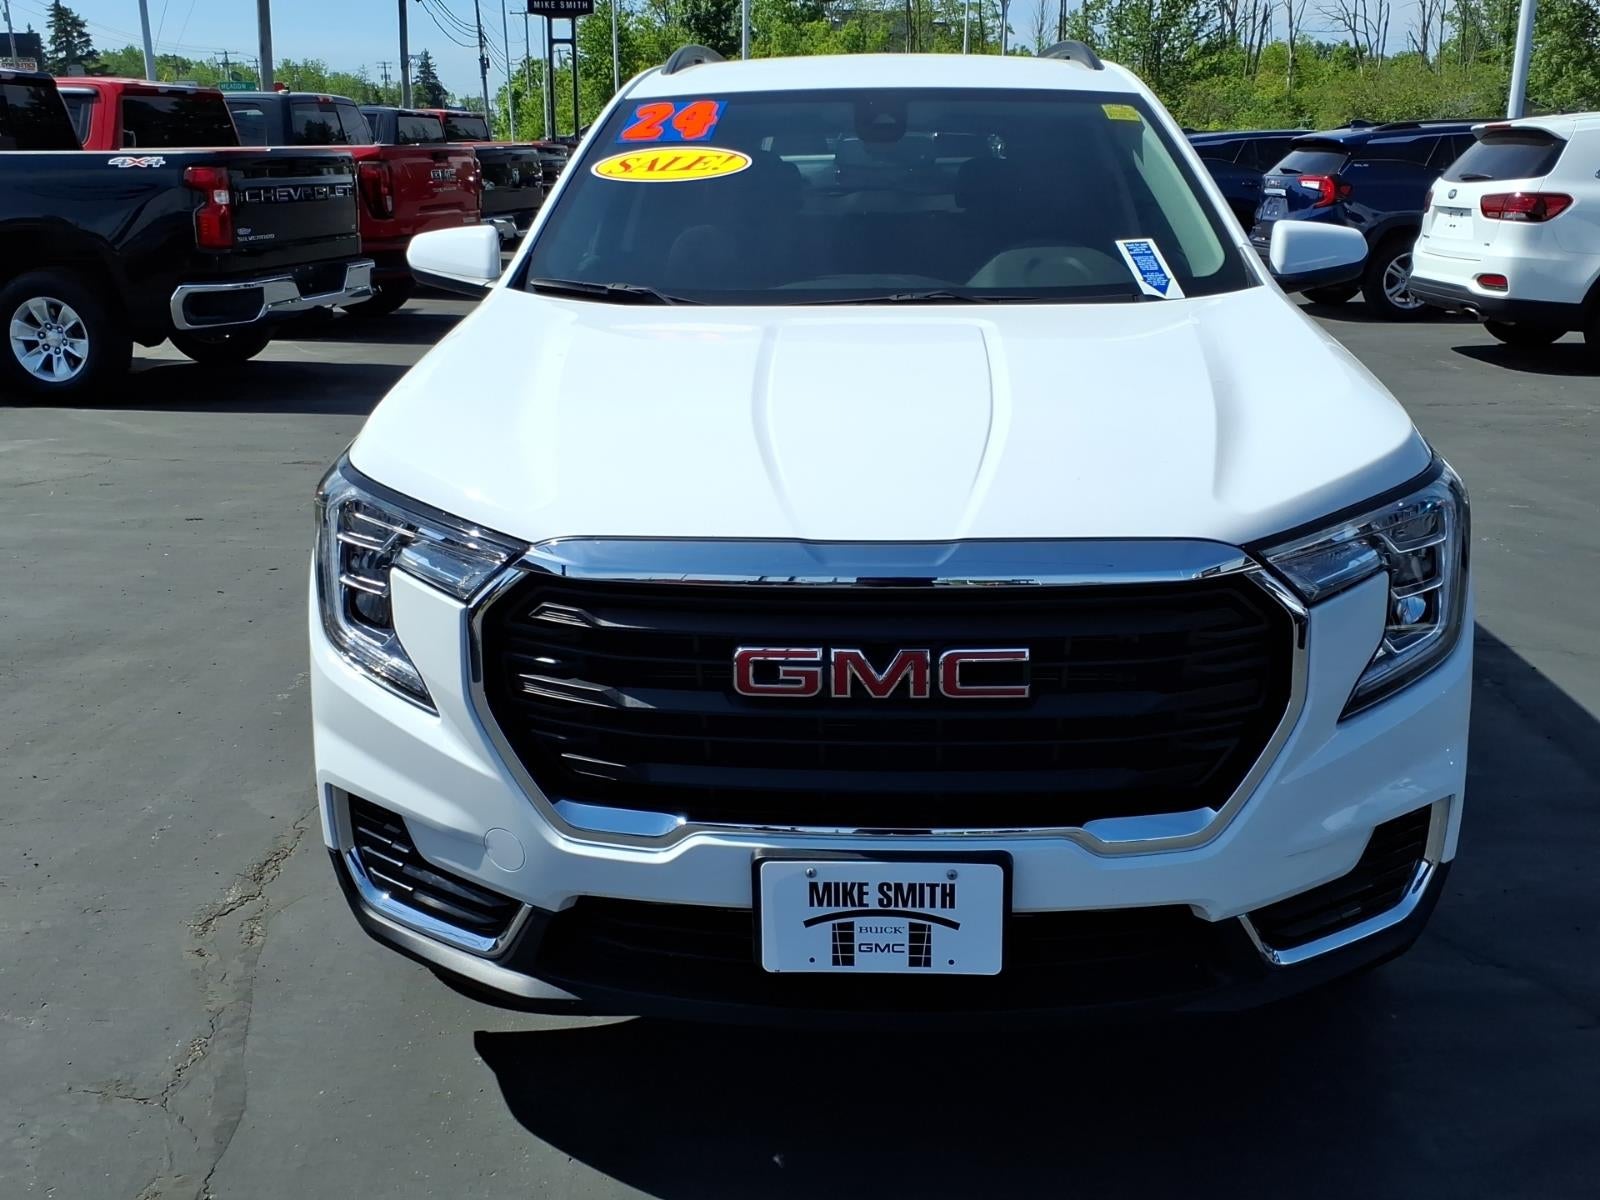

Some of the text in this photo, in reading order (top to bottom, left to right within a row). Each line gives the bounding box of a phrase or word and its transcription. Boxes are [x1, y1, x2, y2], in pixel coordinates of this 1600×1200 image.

[533, 1, 588, 9] MIKE SMITH
[620, 100, 719, 141] 24
[607, 154, 737, 174] SALE!
[245, 184, 353, 202] CHEVROLET
[733, 647, 1029, 699] GMC
[808, 881, 956, 909] MIKE SMITH
[858, 926, 904, 934] BUICK
[858, 943, 905, 953] GMC
